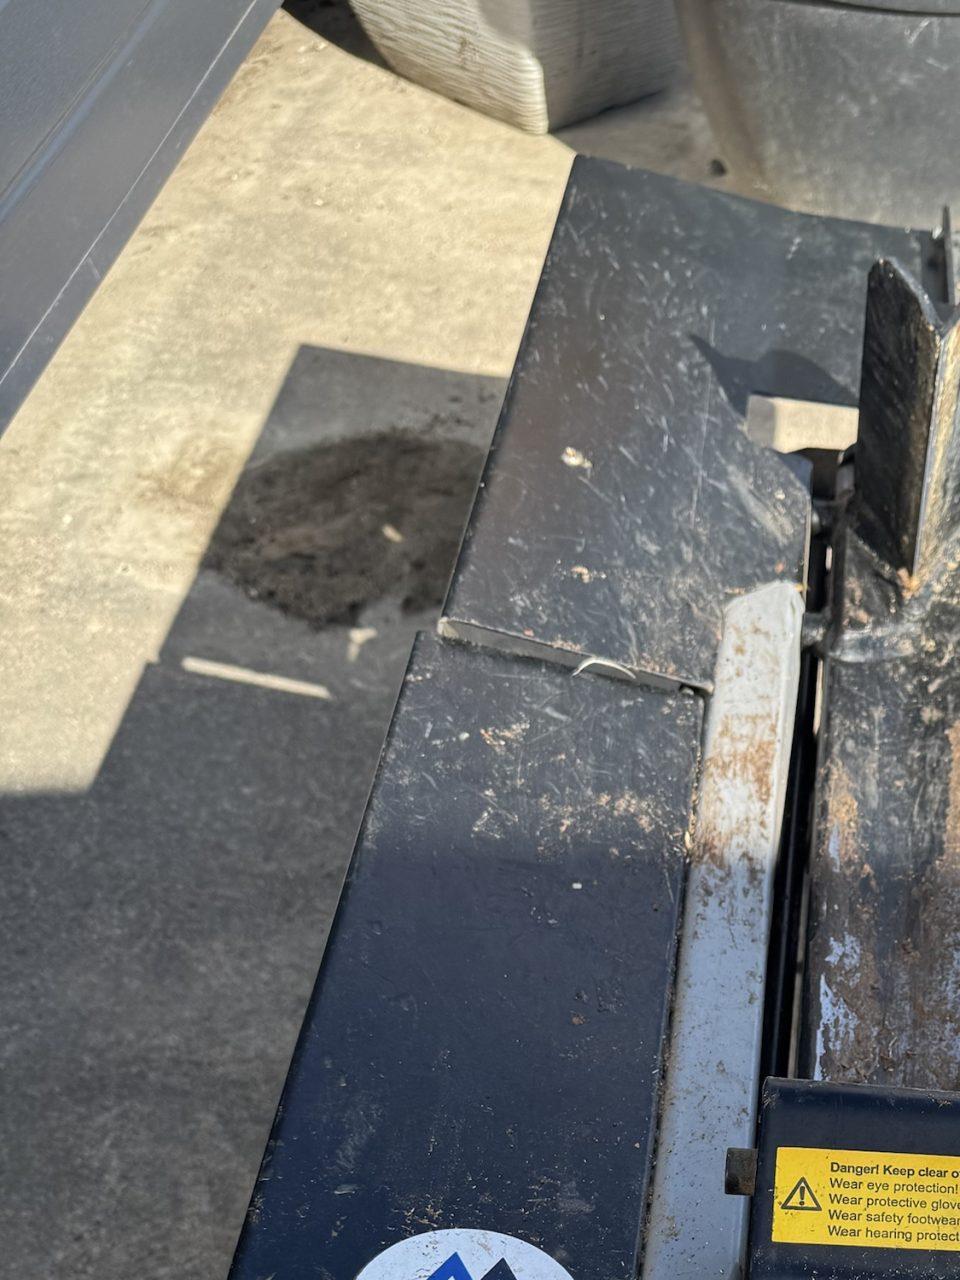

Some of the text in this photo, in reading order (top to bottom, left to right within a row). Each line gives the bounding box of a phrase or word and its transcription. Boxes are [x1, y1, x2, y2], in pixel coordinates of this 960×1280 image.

[830, 1162, 879, 1176] Danger!
[883, 1165, 915, 1178] Keep
[918, 1167, 947, 1178] clear
[830, 1178, 958, 1195] Wear eye protection!
[829, 1195, 863, 1205] Wear
[866, 1196, 927, 1210] protective
[828, 1210, 862, 1221] Wear
[866, 1212, 903, 1225] safety
[828, 1226, 861, 1237] Wear
[865, 1227, 912, 1242] hearing
